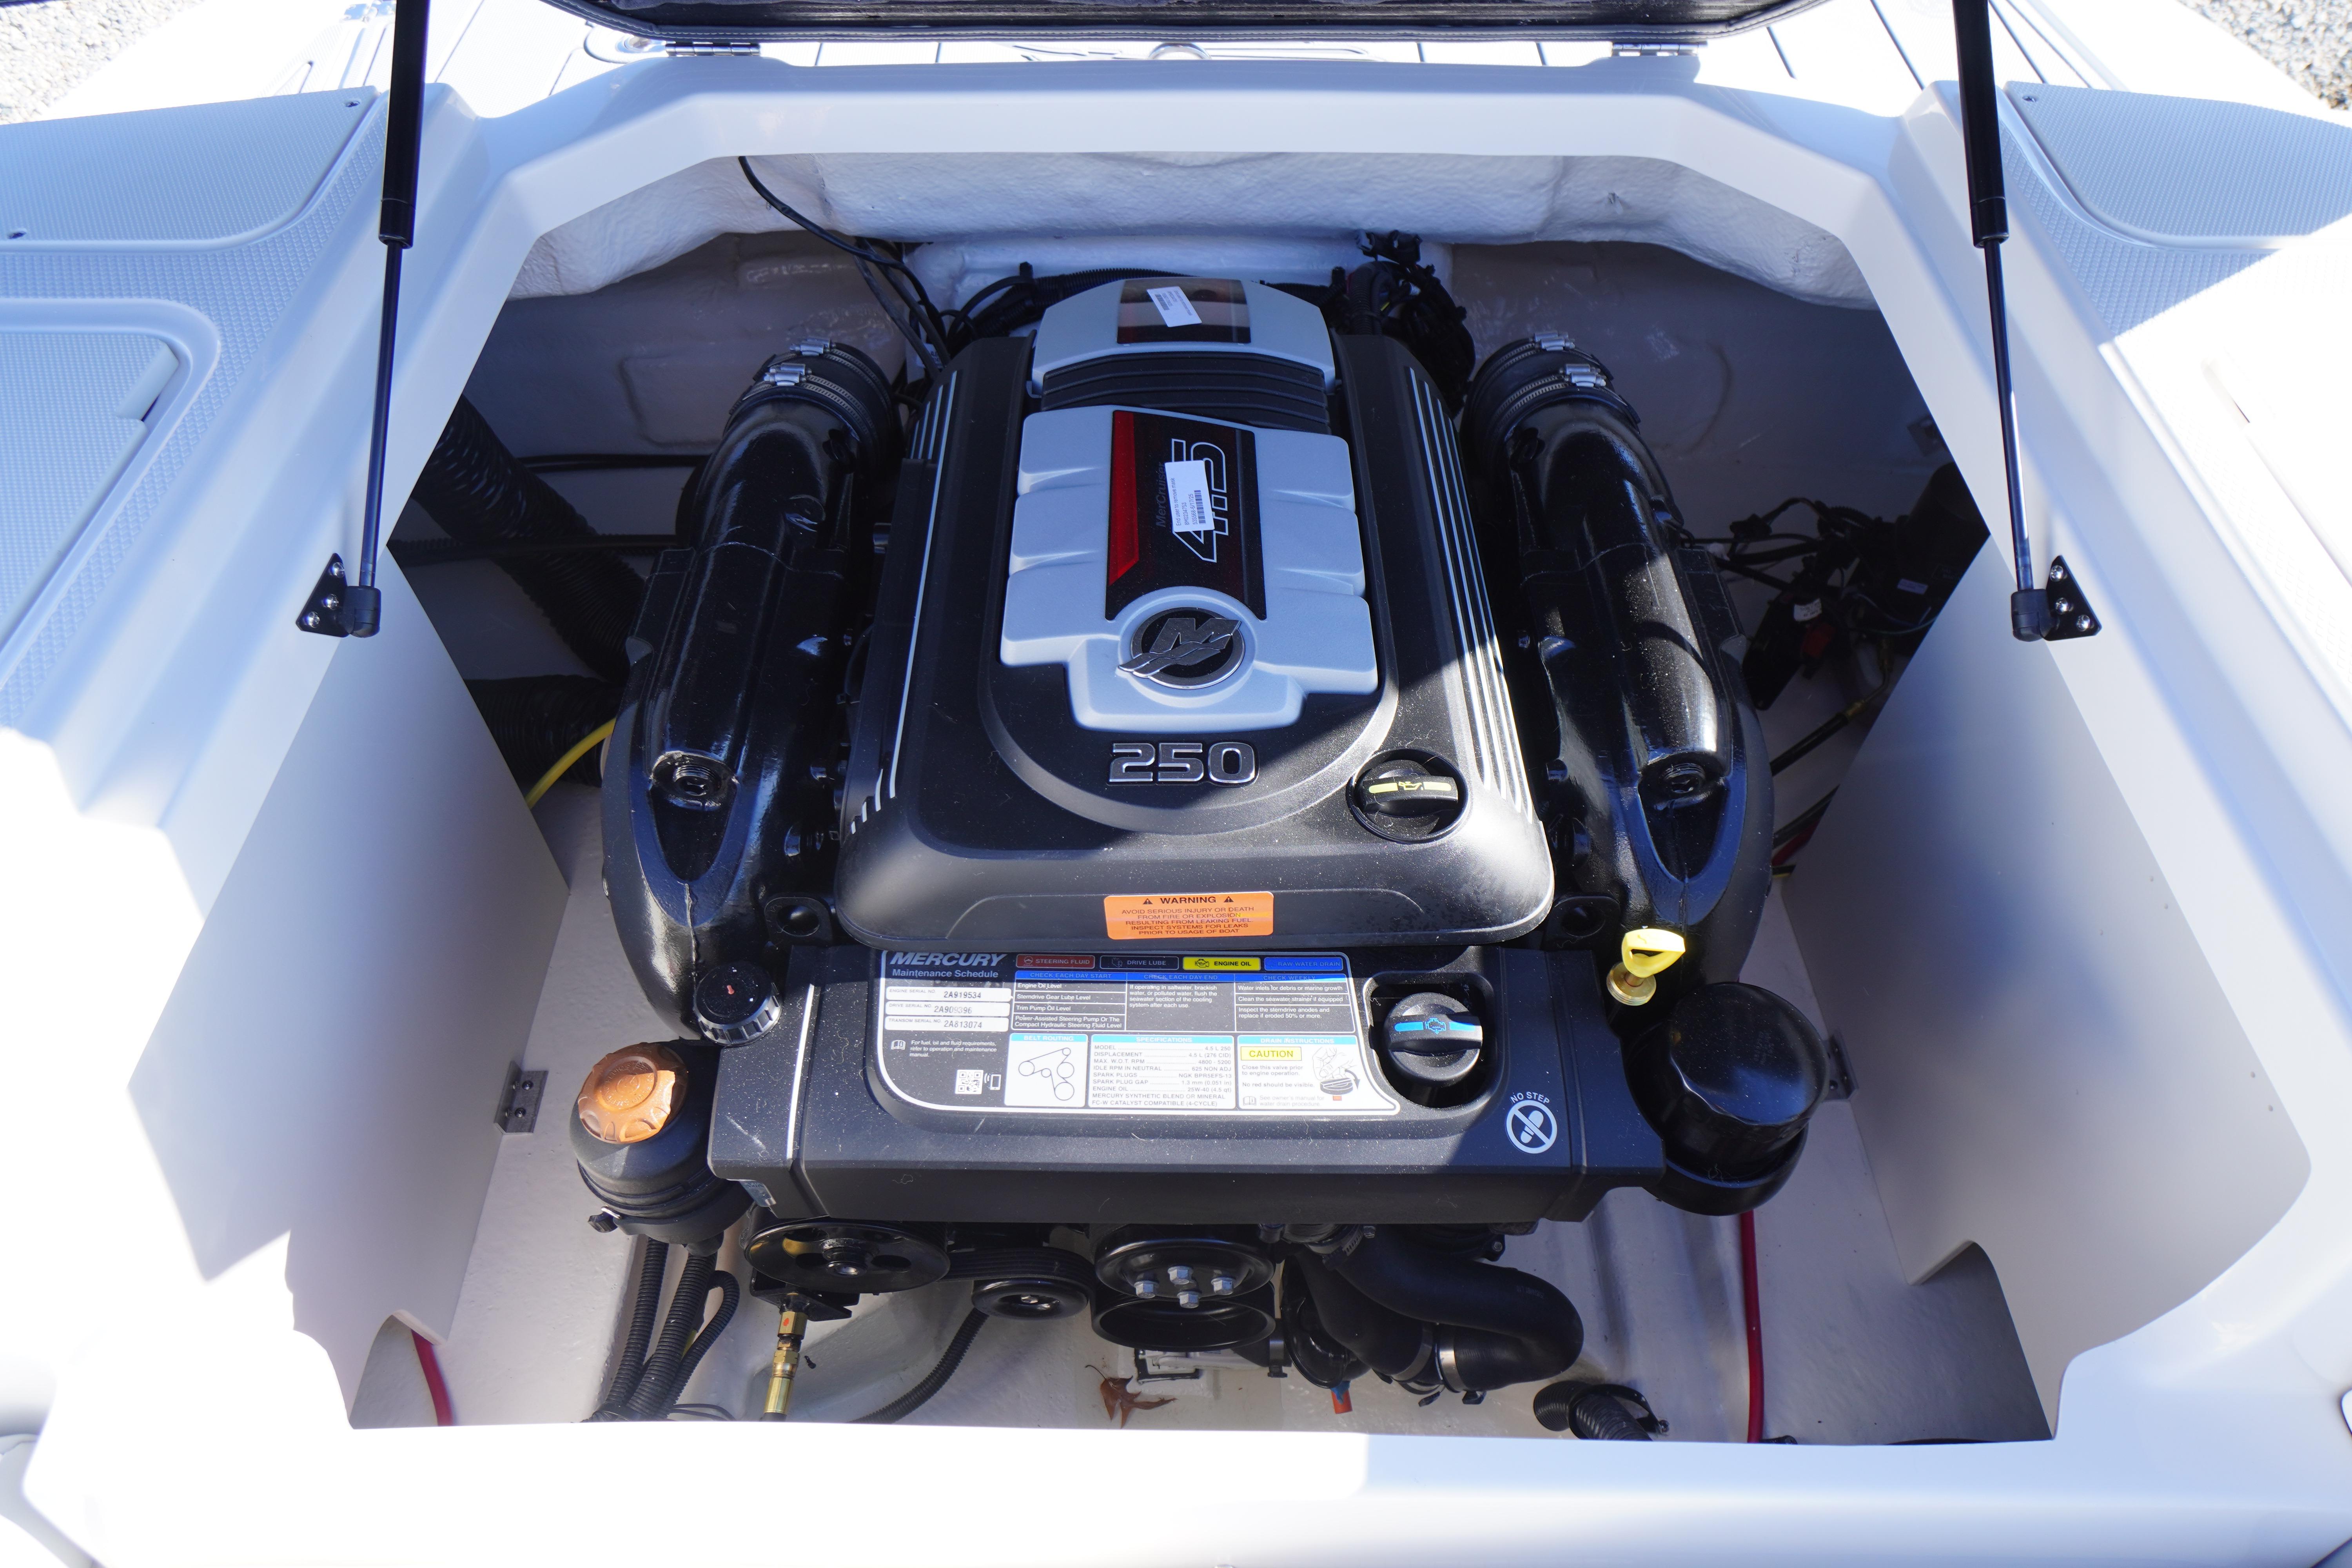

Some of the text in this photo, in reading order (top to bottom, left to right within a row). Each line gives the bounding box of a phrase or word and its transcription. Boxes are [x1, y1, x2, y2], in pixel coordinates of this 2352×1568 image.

[1109, 742, 1256, 784] 250
[1160, 896, 1216, 904] WARNING
[890, 952, 1007, 966] MERCURY
[893, 969, 998, 978] Maintenance Schedule
[1510, 1091, 1550, 1103] NO STEP
